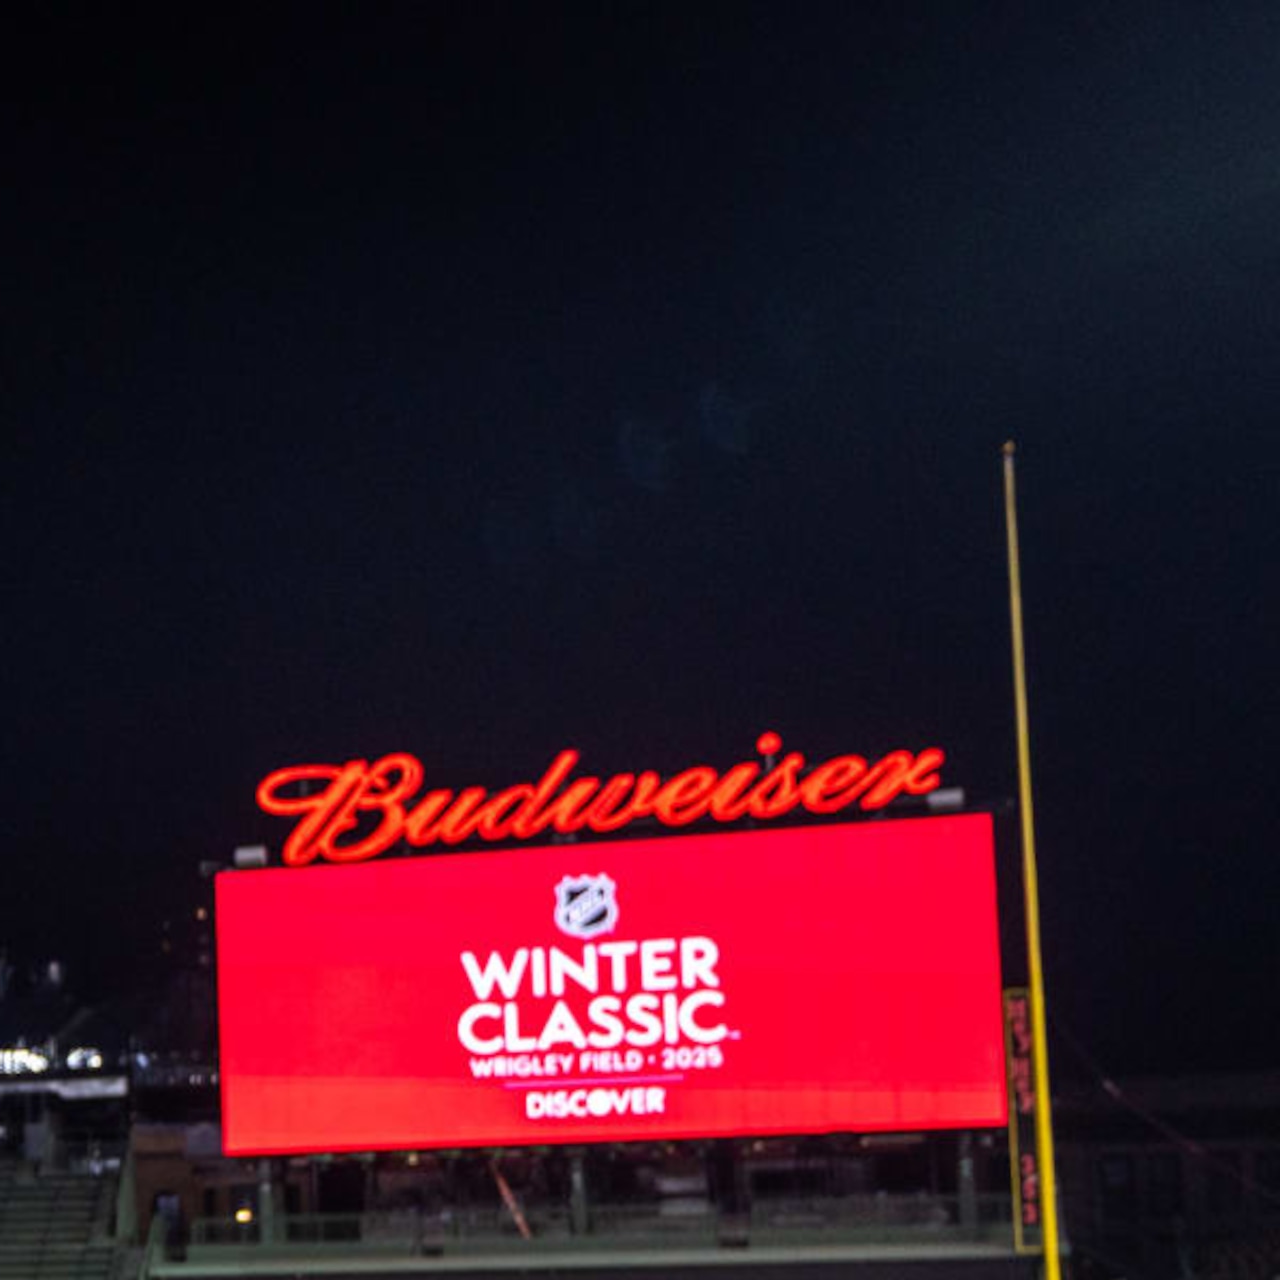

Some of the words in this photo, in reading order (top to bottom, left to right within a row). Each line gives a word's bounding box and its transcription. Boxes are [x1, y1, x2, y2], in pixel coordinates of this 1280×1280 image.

[256, 730, 945, 867] Budweiser
[459, 935, 720, 1002] WINTER
[456, 988, 728, 1056] CLASSIC
[468, 1052, 574, 1079] WRIGLEY
[579, 1049, 644, 1073] FIELD
[661, 1044, 724, 1071] 2025
[524, 1085, 666, 1120] DISCOVER
